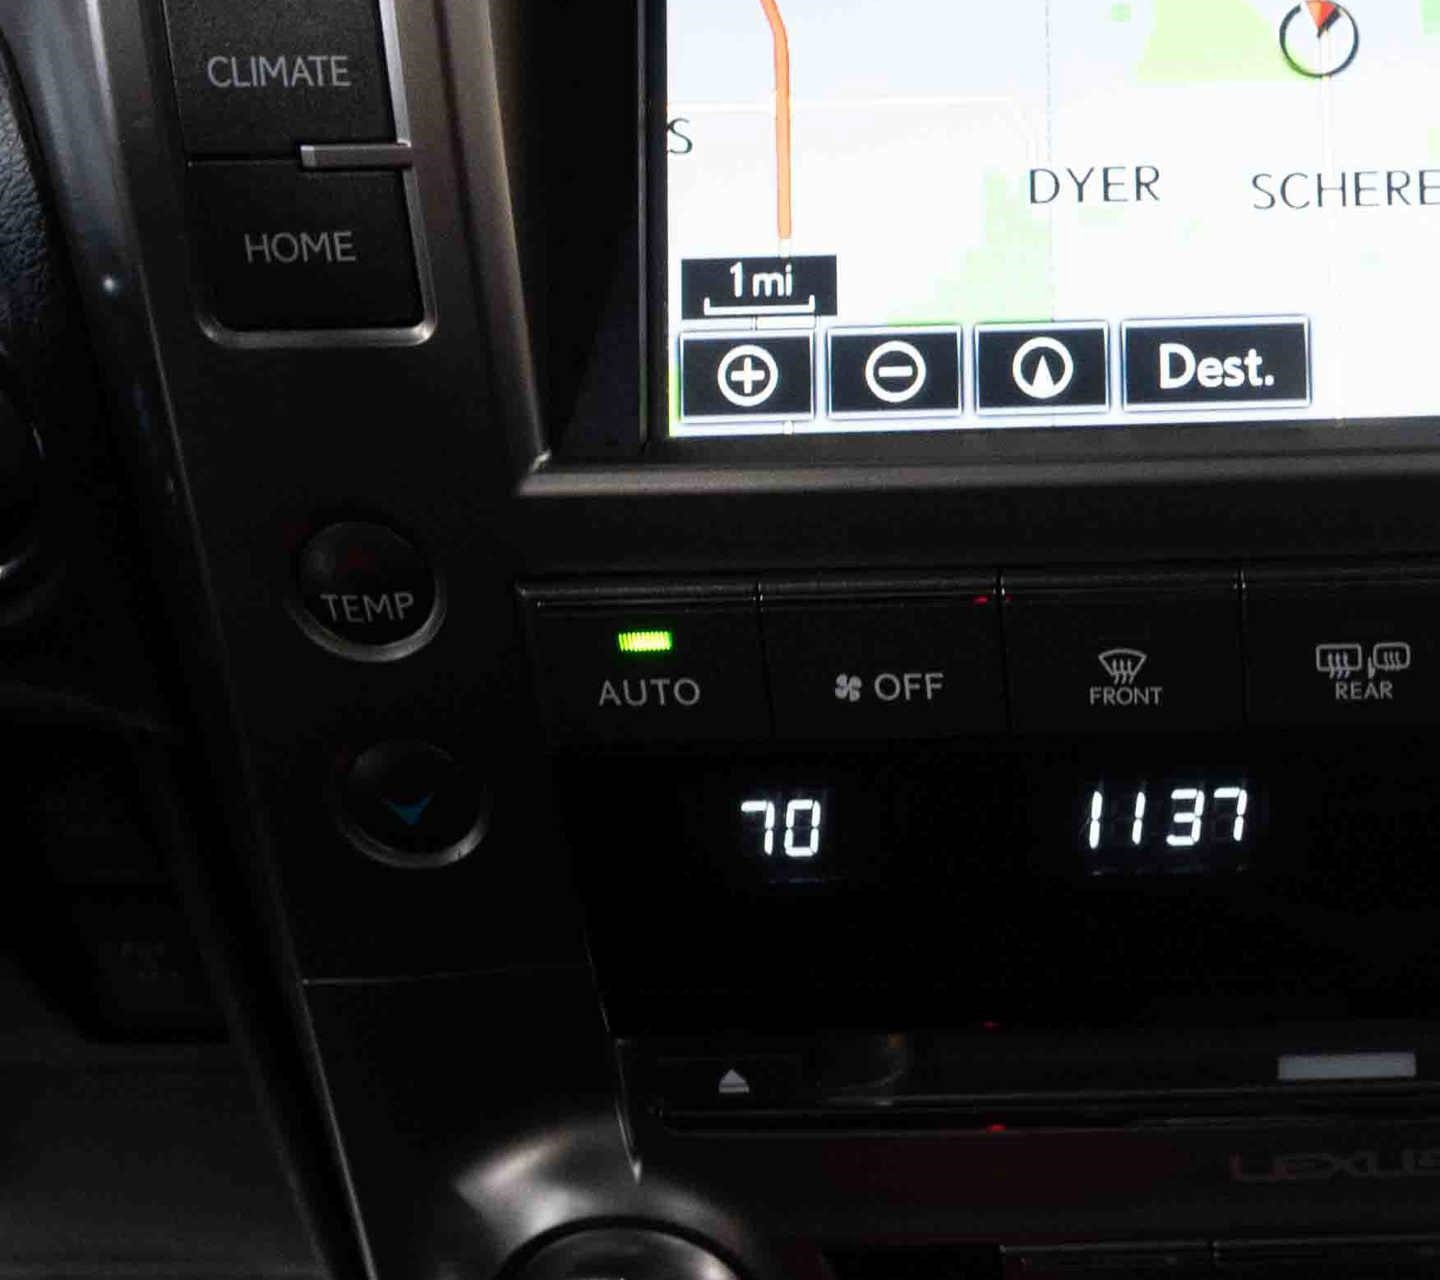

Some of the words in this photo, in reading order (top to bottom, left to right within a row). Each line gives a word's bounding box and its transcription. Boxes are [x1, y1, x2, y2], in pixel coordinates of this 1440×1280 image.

[207, 56, 352, 86] CLIMATE
[1027, 164, 1160, 205] DYER
[245, 231, 356, 263] HOME
[728, 261, 743, 297] 1
[750, 261, 794, 297] mi
[1160, 345, 1274, 393] Dest.
[321, 591, 414, 624] TEMP
[598, 677, 701, 708] AUTO
[873, 673, 944, 702] OFF
[1089, 686, 1162, 705] FRONT
[1335, 680, 1392, 700] REAR
[741, 799, 821, 857] 70
